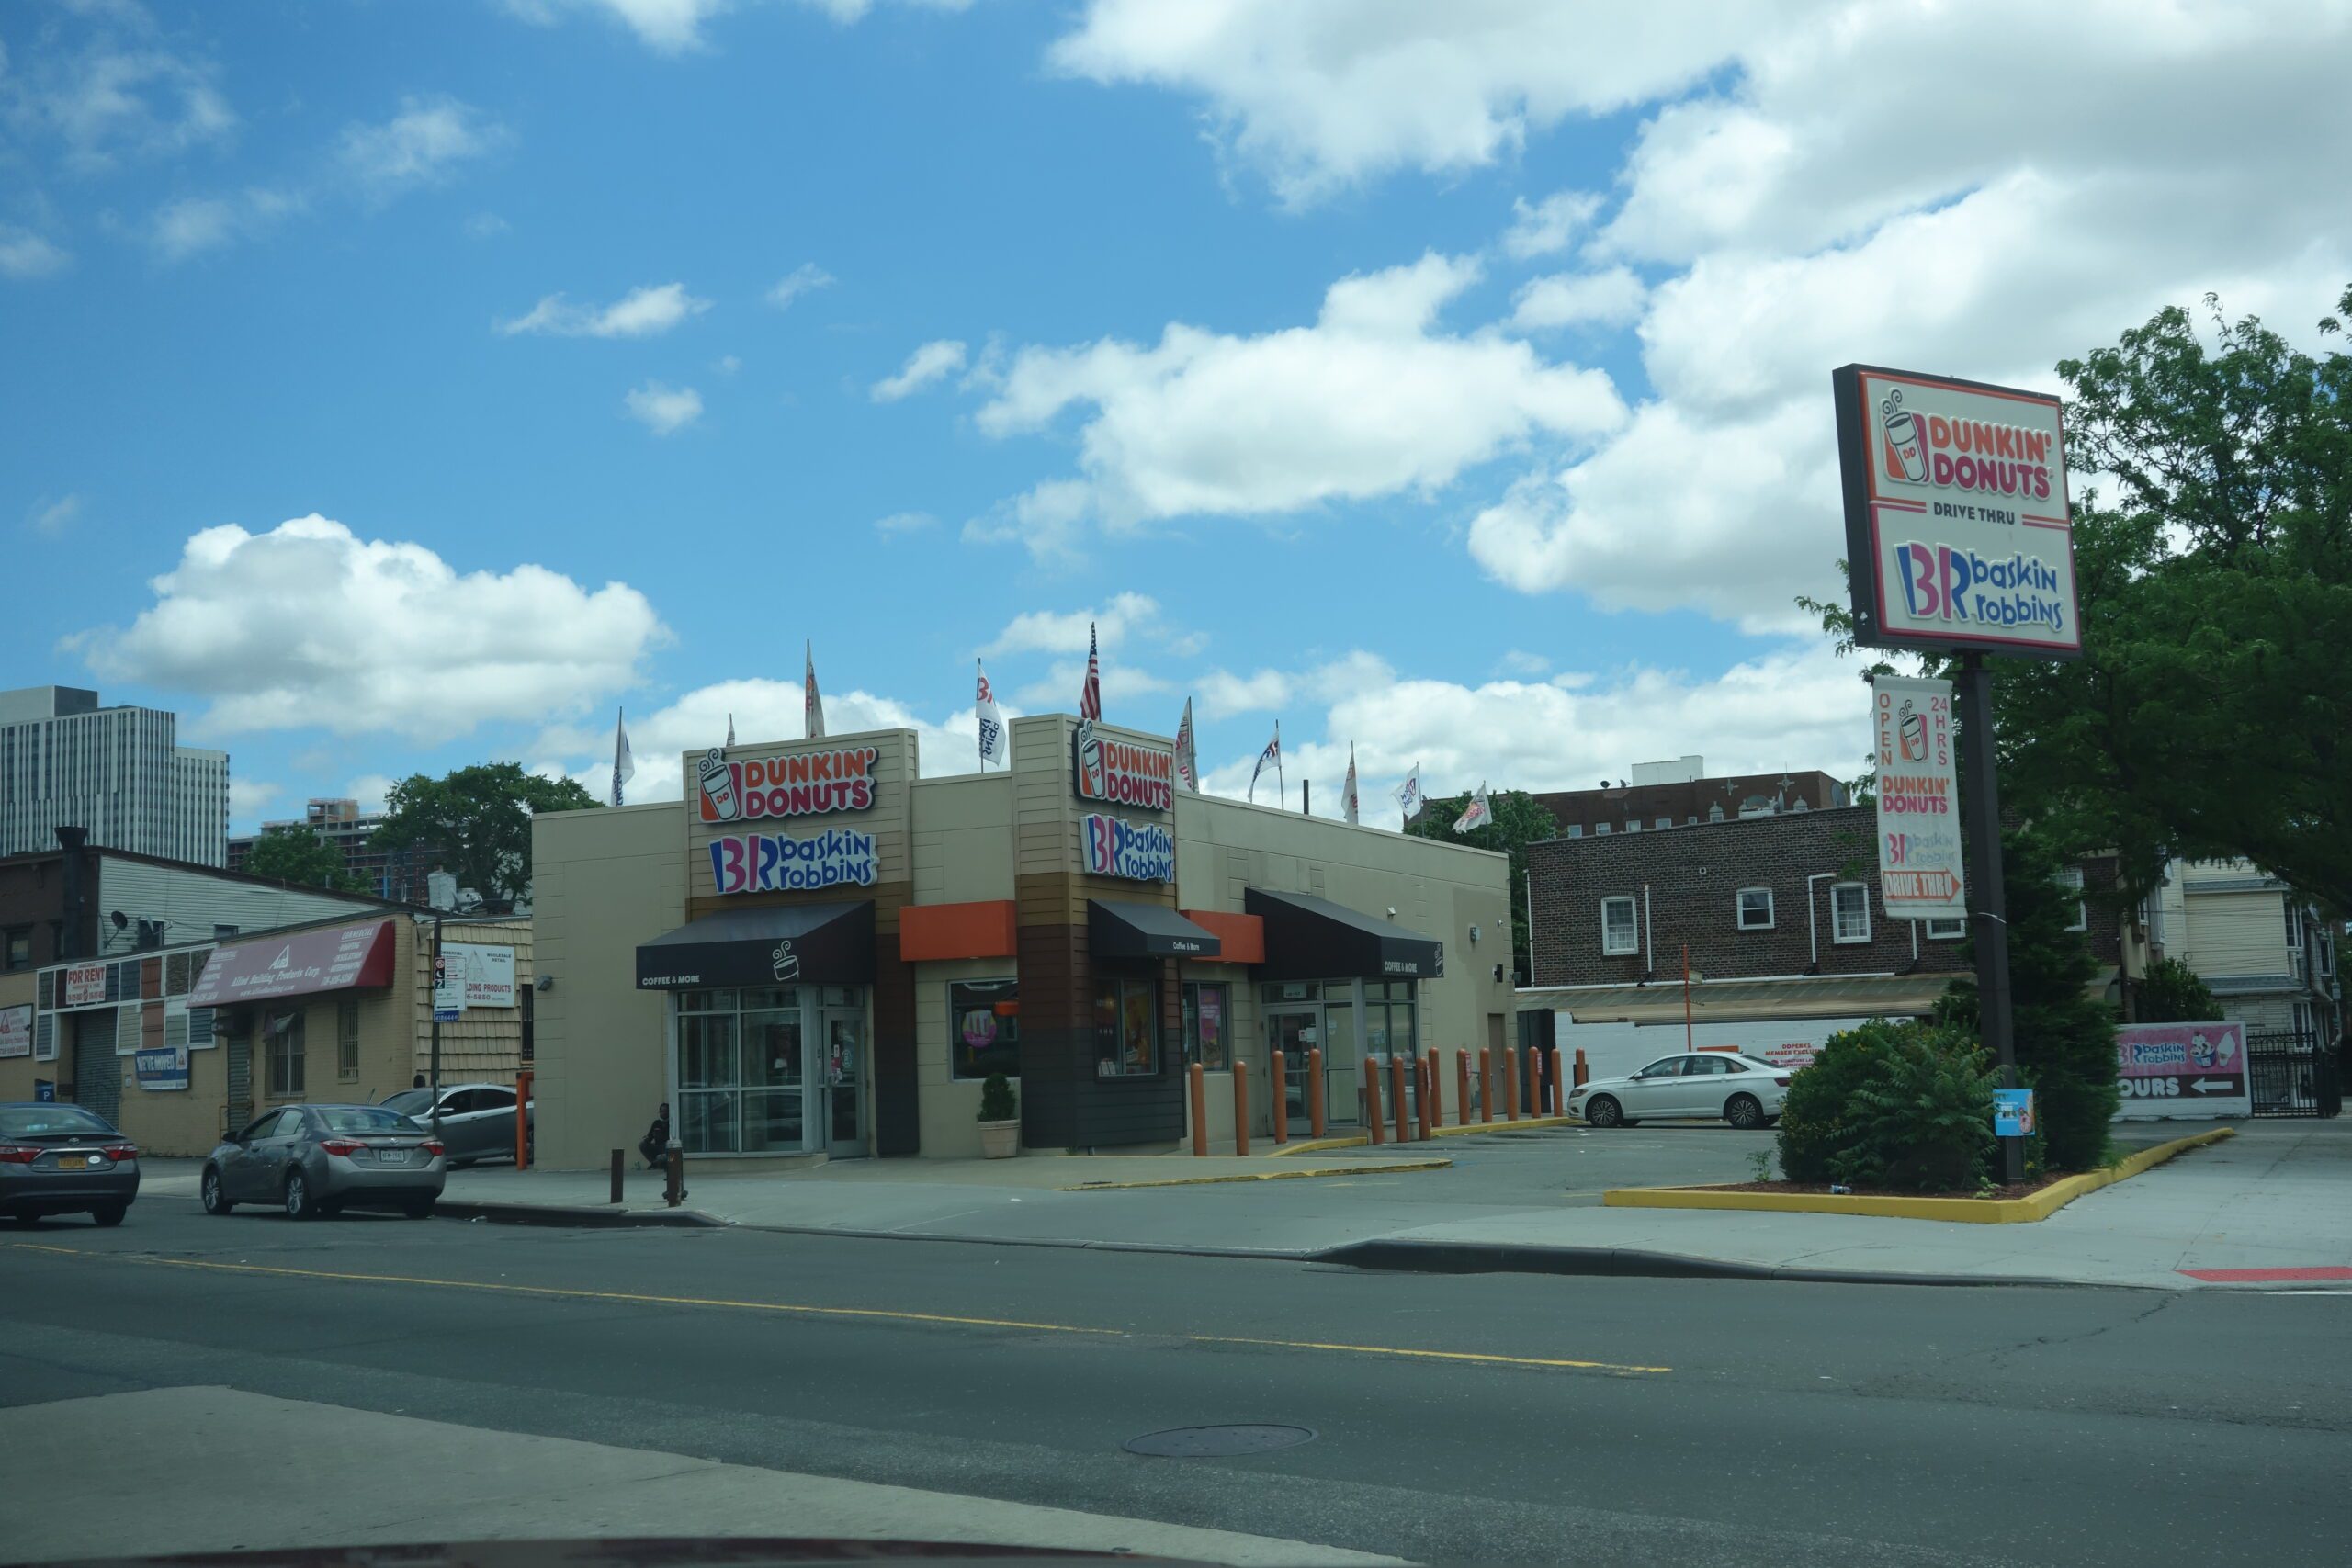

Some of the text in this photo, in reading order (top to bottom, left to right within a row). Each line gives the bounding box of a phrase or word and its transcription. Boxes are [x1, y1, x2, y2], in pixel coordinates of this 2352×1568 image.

[1903, 446, 1917, 460] DD
[1929, 415, 2052, 463] DUNKIN'
[1934, 453, 2051, 500] DONUTS
[1933, 502, 2016, 525] DRIVE THRU
[1896, 542, 1972, 620] BR
[1970, 551, 2058, 594] baskin
[1976, 593, 2063, 630] robbins
[1931, 696, 1948, 712] 24
[1878, 693, 1893, 766] OPEN
[1935, 714, 1948, 766] HRS
[745, 748, 873, 788] DUNKIN'
[1106, 742, 1172, 781] DUNKIN'
[717, 792, 729, 804] DD
[746, 779, 869, 818] DONUTS
[1108, 773, 1170, 810] DONUTS
[1882, 775, 1950, 795] DUNKIN'
[1883, 795, 1948, 814] DONUTS
[778, 829, 870, 862] baskin
[1088, 815, 1125, 875] BR
[1125, 821, 1172, 858] baskin
[709, 835, 779, 893] BR
[779, 859, 871, 889] robbins
[1125, 852, 1172, 882] robbins
[1884, 874, 1953, 897] DRIVE THRU
[68, 967, 105, 985] FOR RENT
[276, 970, 303, 981] Products
[642, 976, 671, 985] COFFEE
[678, 975, 700, 983] MORE
[1384, 961, 1400, 972] COFFEE
[1404, 963, 1417, 973] MORE
[483, 984, 511, 992] PRODUCTS
[2143, 1043, 2185, 1053] baskin
[2143, 1053, 2185, 1064] robbins
[44, 1091, 50, 1100] P
[2116, 1077, 2180, 1097] OURS
